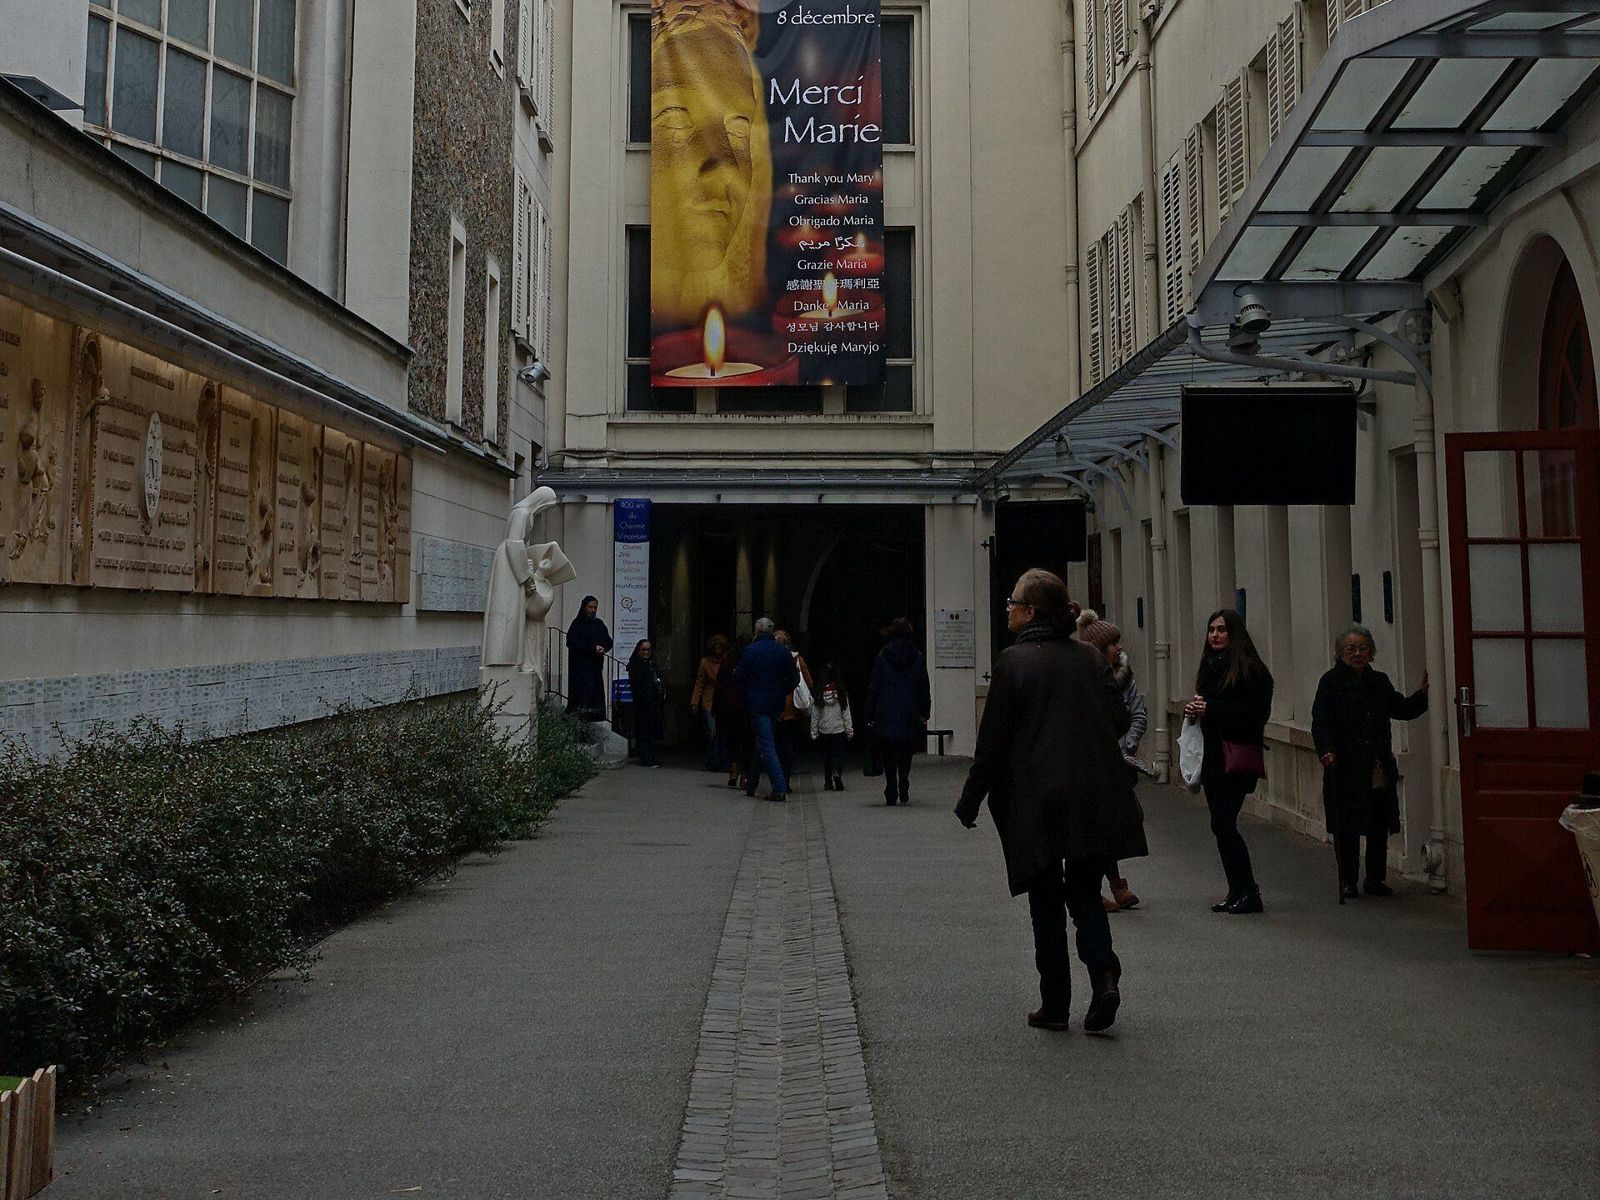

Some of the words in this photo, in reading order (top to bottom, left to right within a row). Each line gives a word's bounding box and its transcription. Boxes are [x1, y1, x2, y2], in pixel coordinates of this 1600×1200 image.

[777, 10, 787, 25] 8
[791, 5, 875, 25] décembre
[769, 75, 864, 105] Merci
[784, 113, 880, 144] Marie
[788, 172, 821, 184] Thank
[824, 175, 843, 186] you
[846, 173, 874, 185] Mary
[794, 194, 834, 205] Gracias
[837, 193, 869, 204] Maria
[789, 215, 840, 229] Obrigado
[843, 215, 874, 226] Maria
[797, 258, 833, 270] Grazie
[836, 258, 867, 269] Maria
[793, 299, 829, 311] Danke
[837, 299, 870, 310] Maria
[786, 322, 819, 333] 성모님
[824, 321, 880, 332] 감사합니다
[787, 341, 838, 355] Dziękuję
[840, 341, 880, 355] Maryjo
